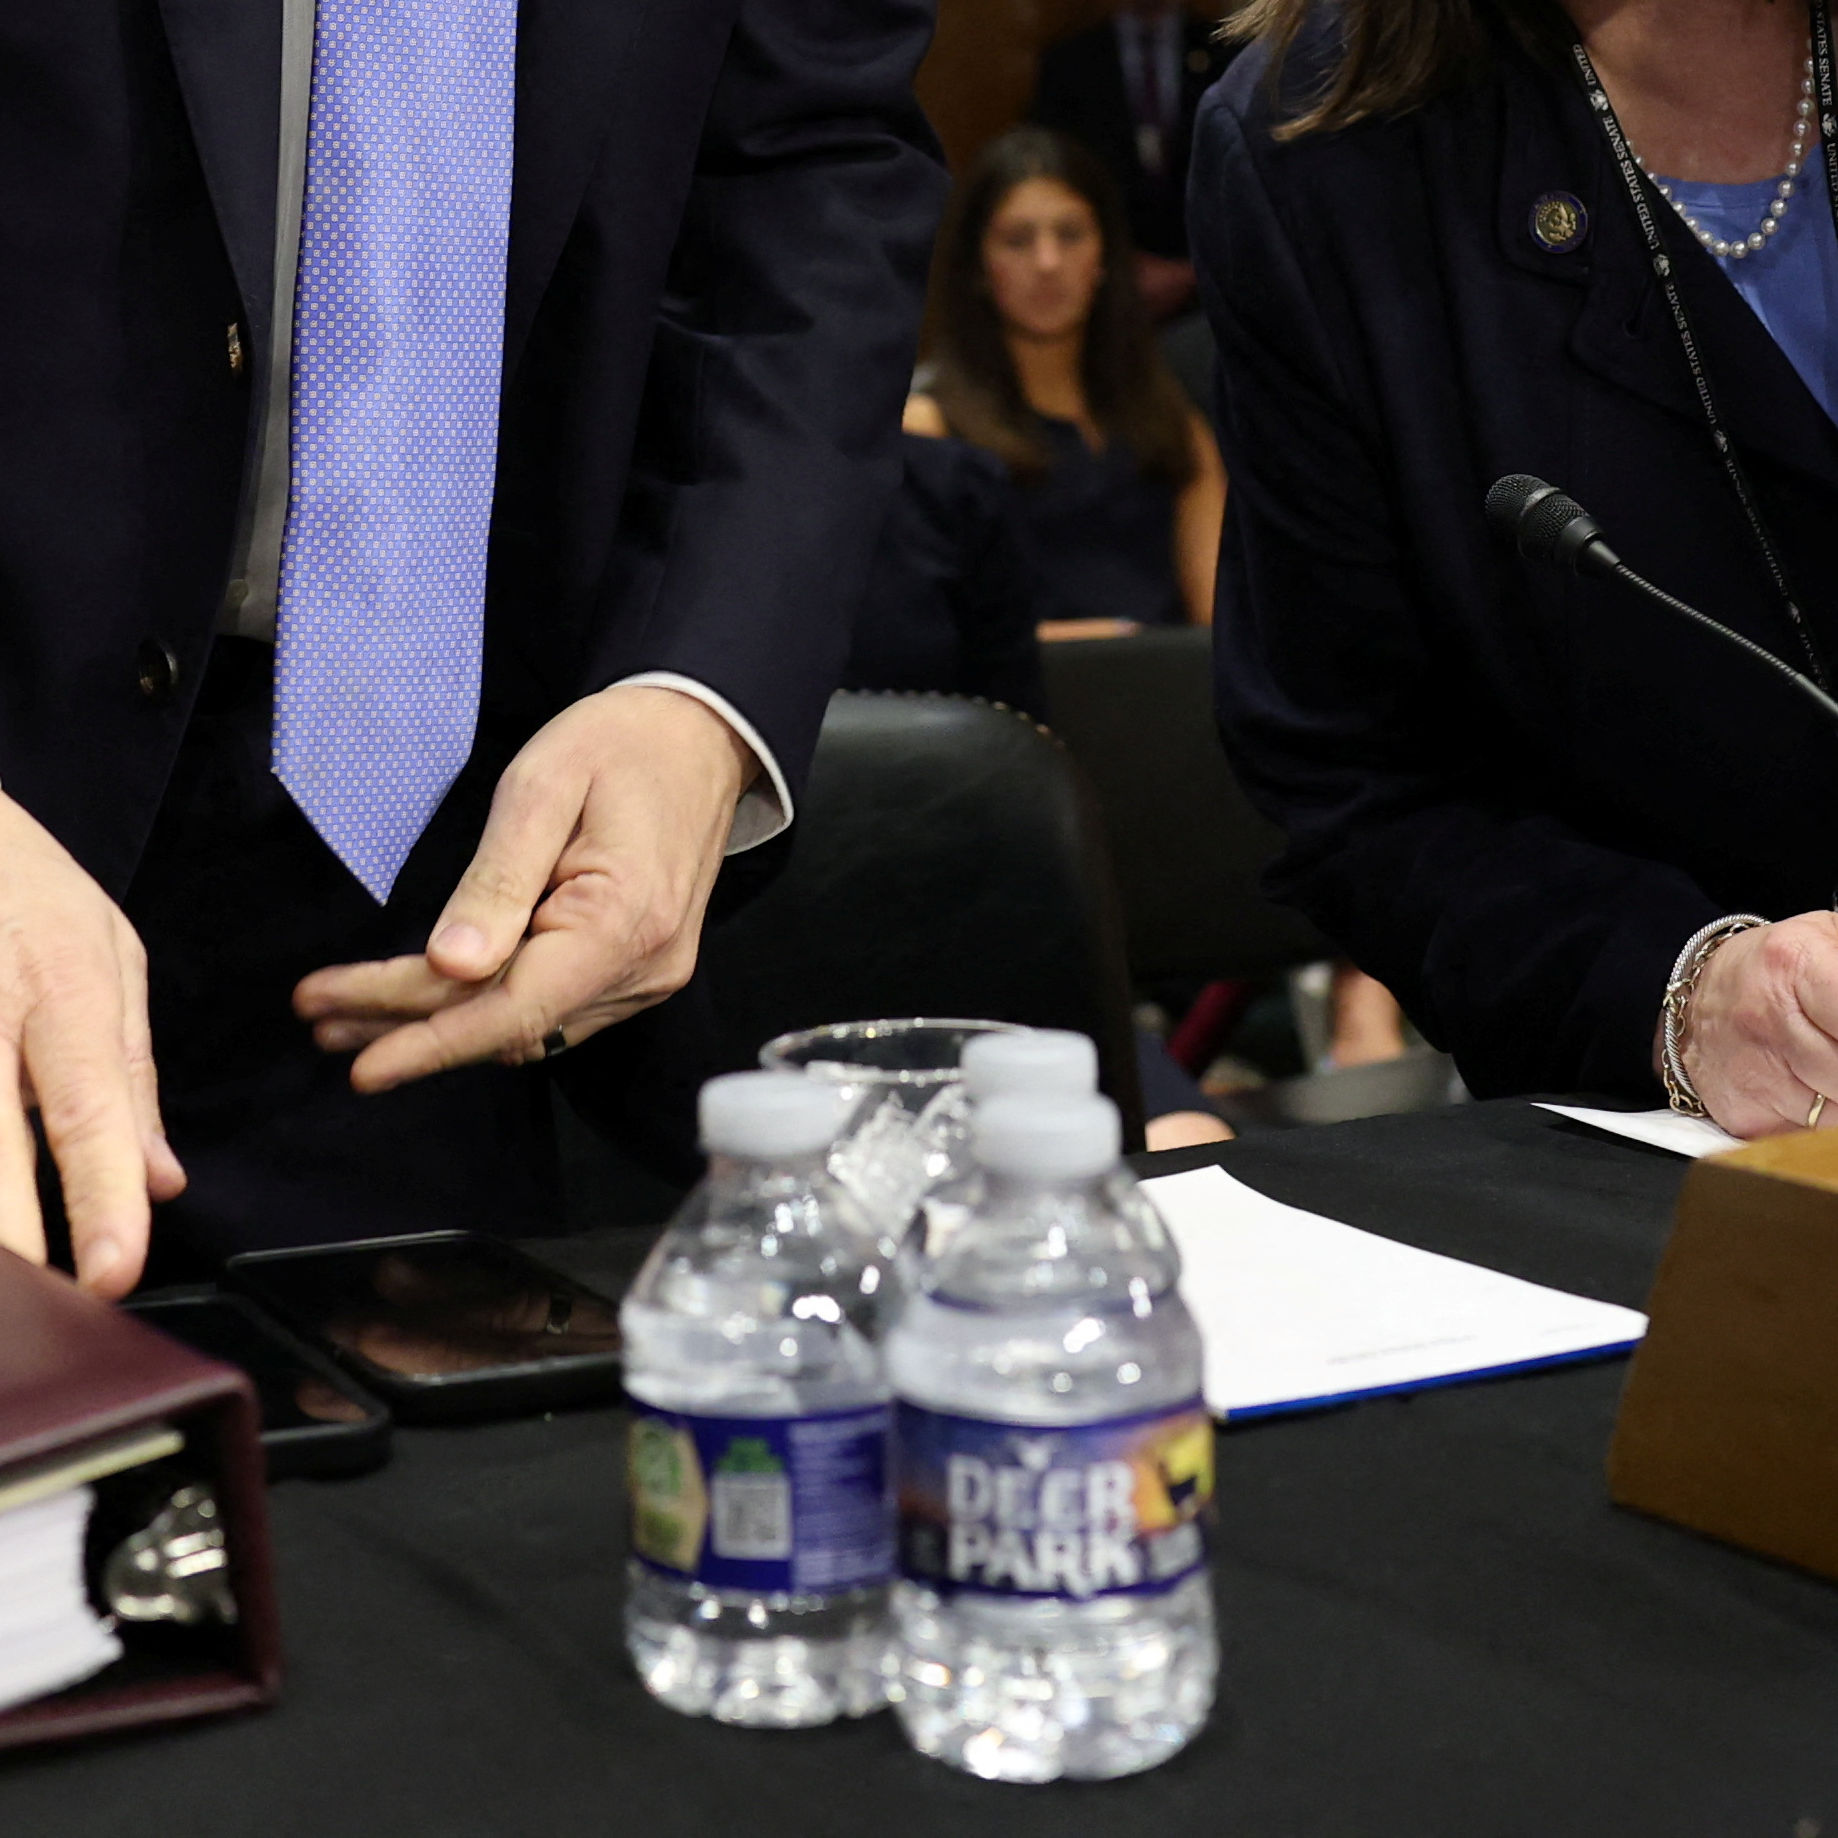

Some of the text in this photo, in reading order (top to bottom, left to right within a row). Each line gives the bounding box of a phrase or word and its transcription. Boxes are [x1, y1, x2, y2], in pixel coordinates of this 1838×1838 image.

[1571, 41, 1597, 87] UNITED
[1817, 57, 1833, 107] SENATE
[1602, 113, 1662, 250] UNITED STATES SENATE
[1663, 281, 1719, 426] UNITED STATES SENATE
[945, 1452, 1139, 1530] DEER
[945, 1518, 1142, 1598] PARK
